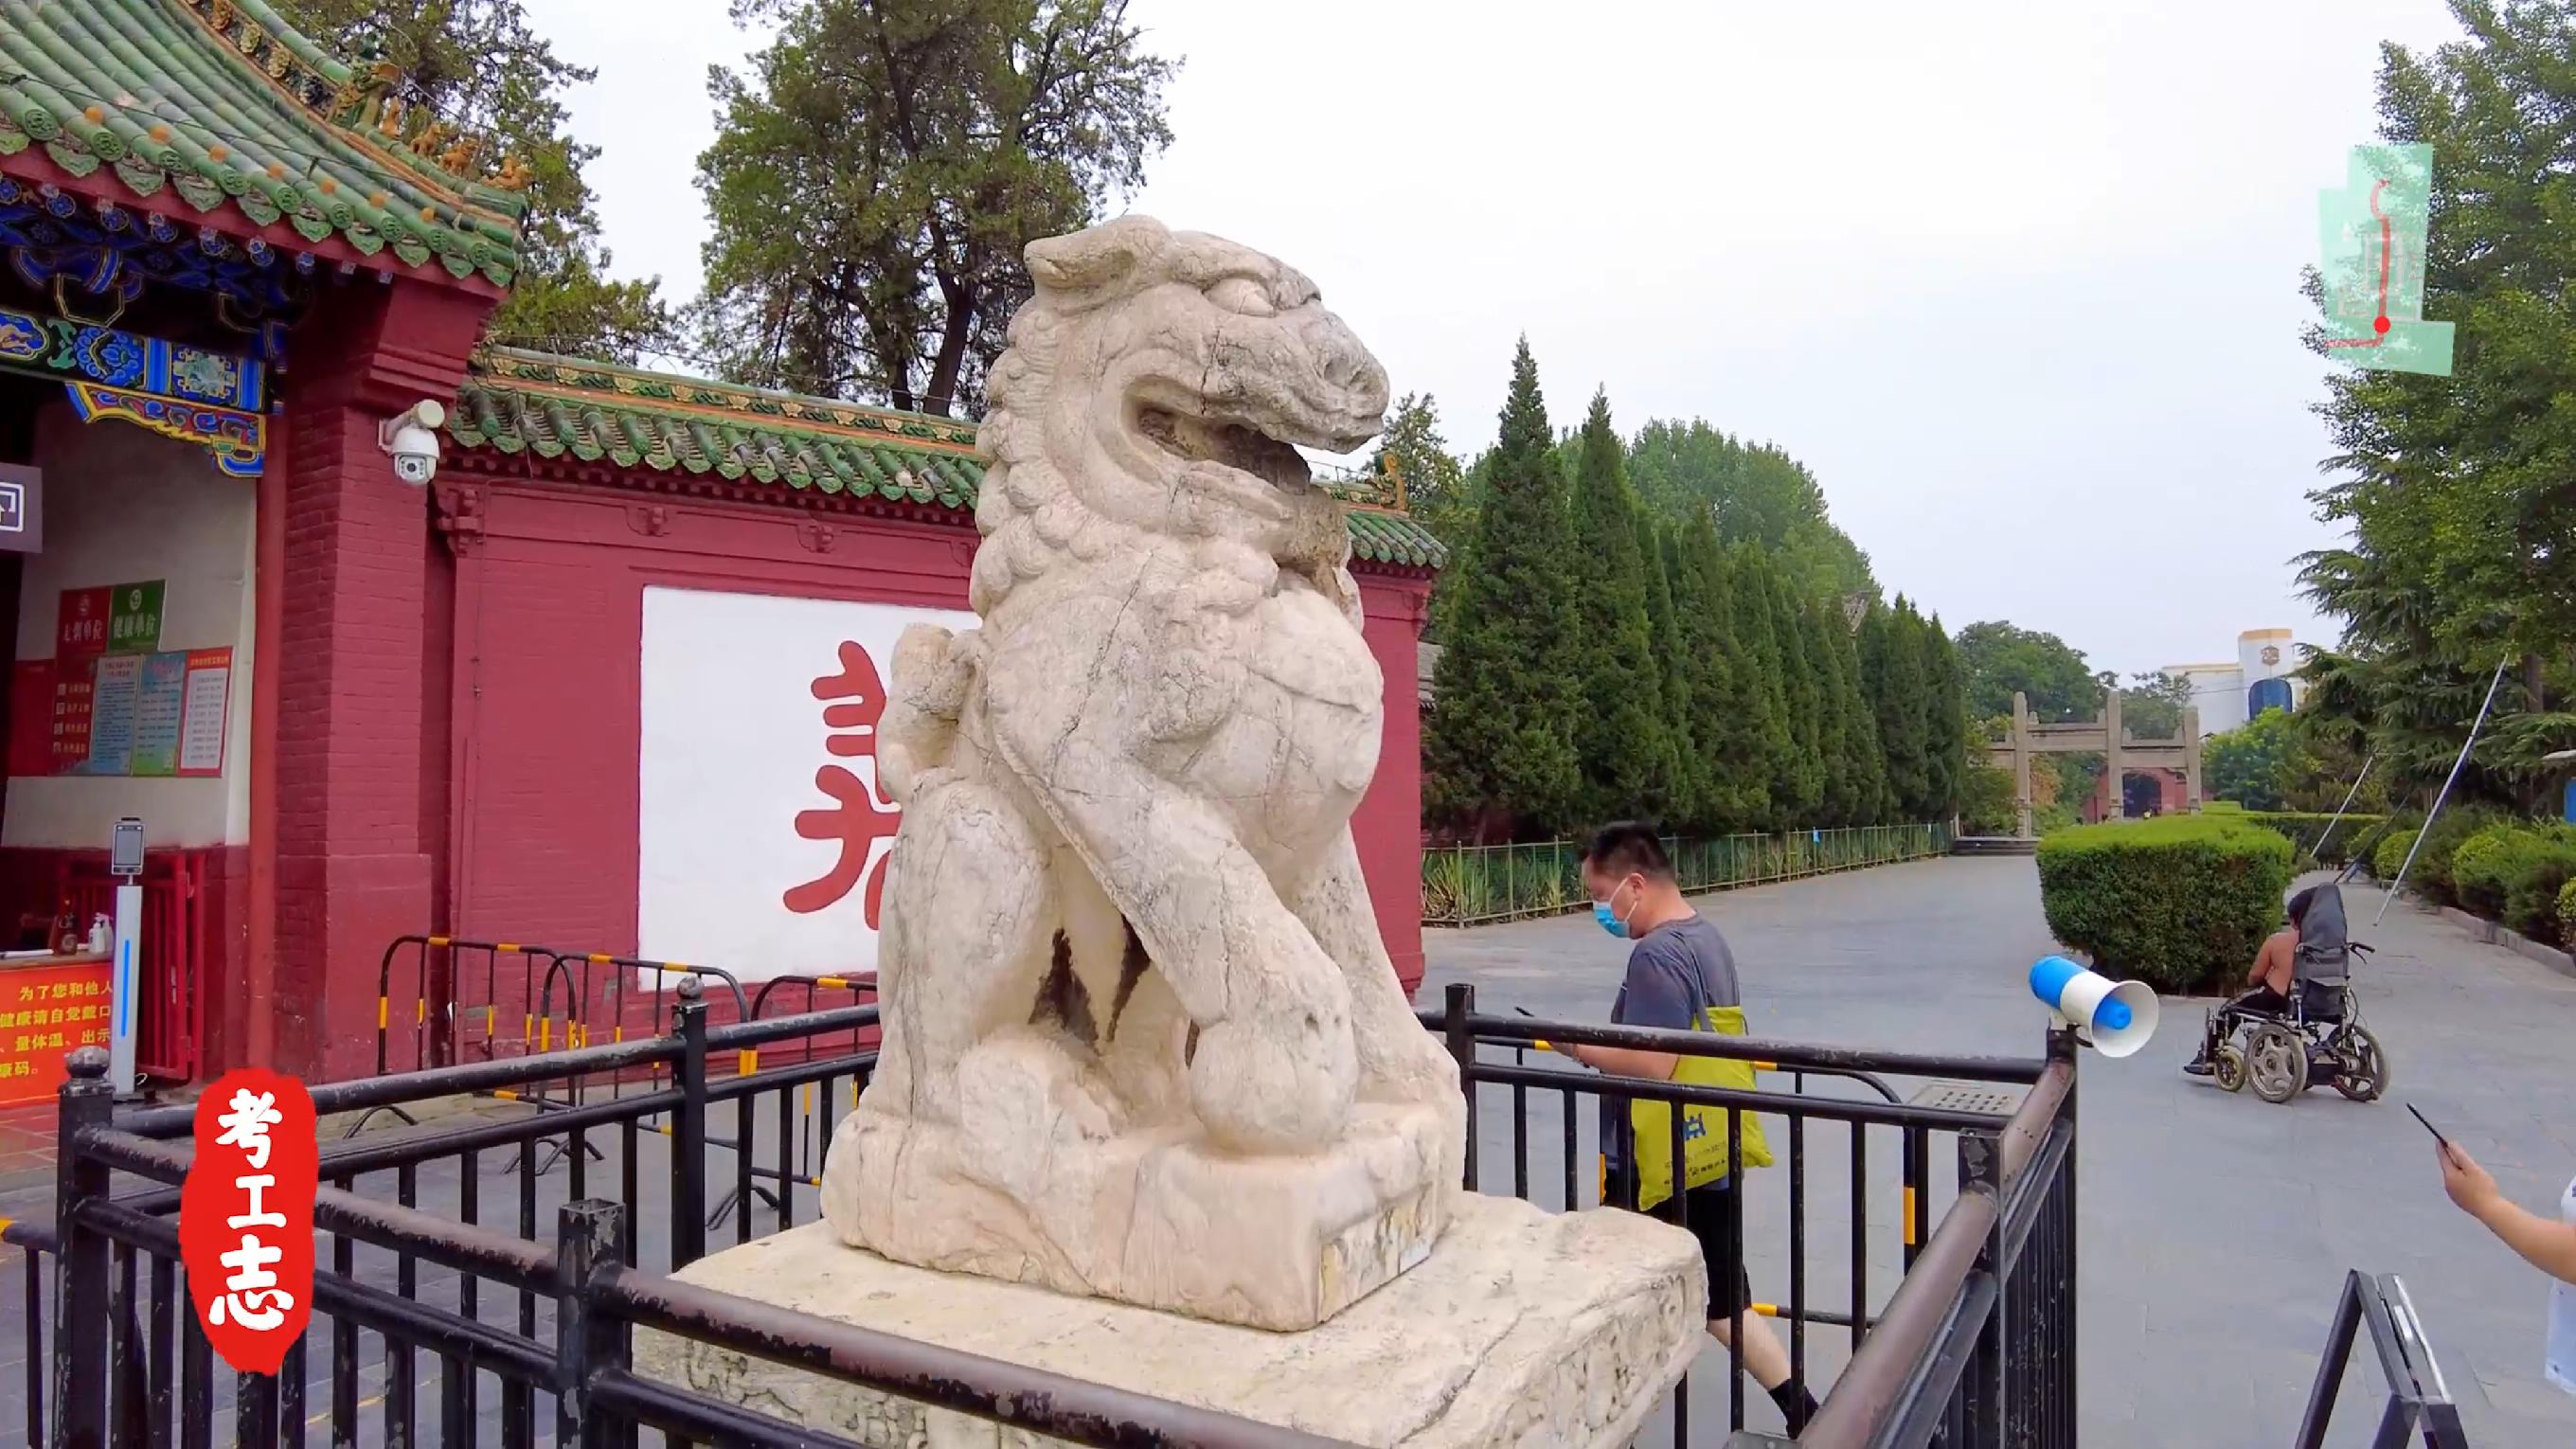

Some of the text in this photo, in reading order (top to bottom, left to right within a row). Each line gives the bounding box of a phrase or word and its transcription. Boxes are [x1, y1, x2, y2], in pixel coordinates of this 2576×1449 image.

[19, 980, 113, 1002] 为了您和他人
